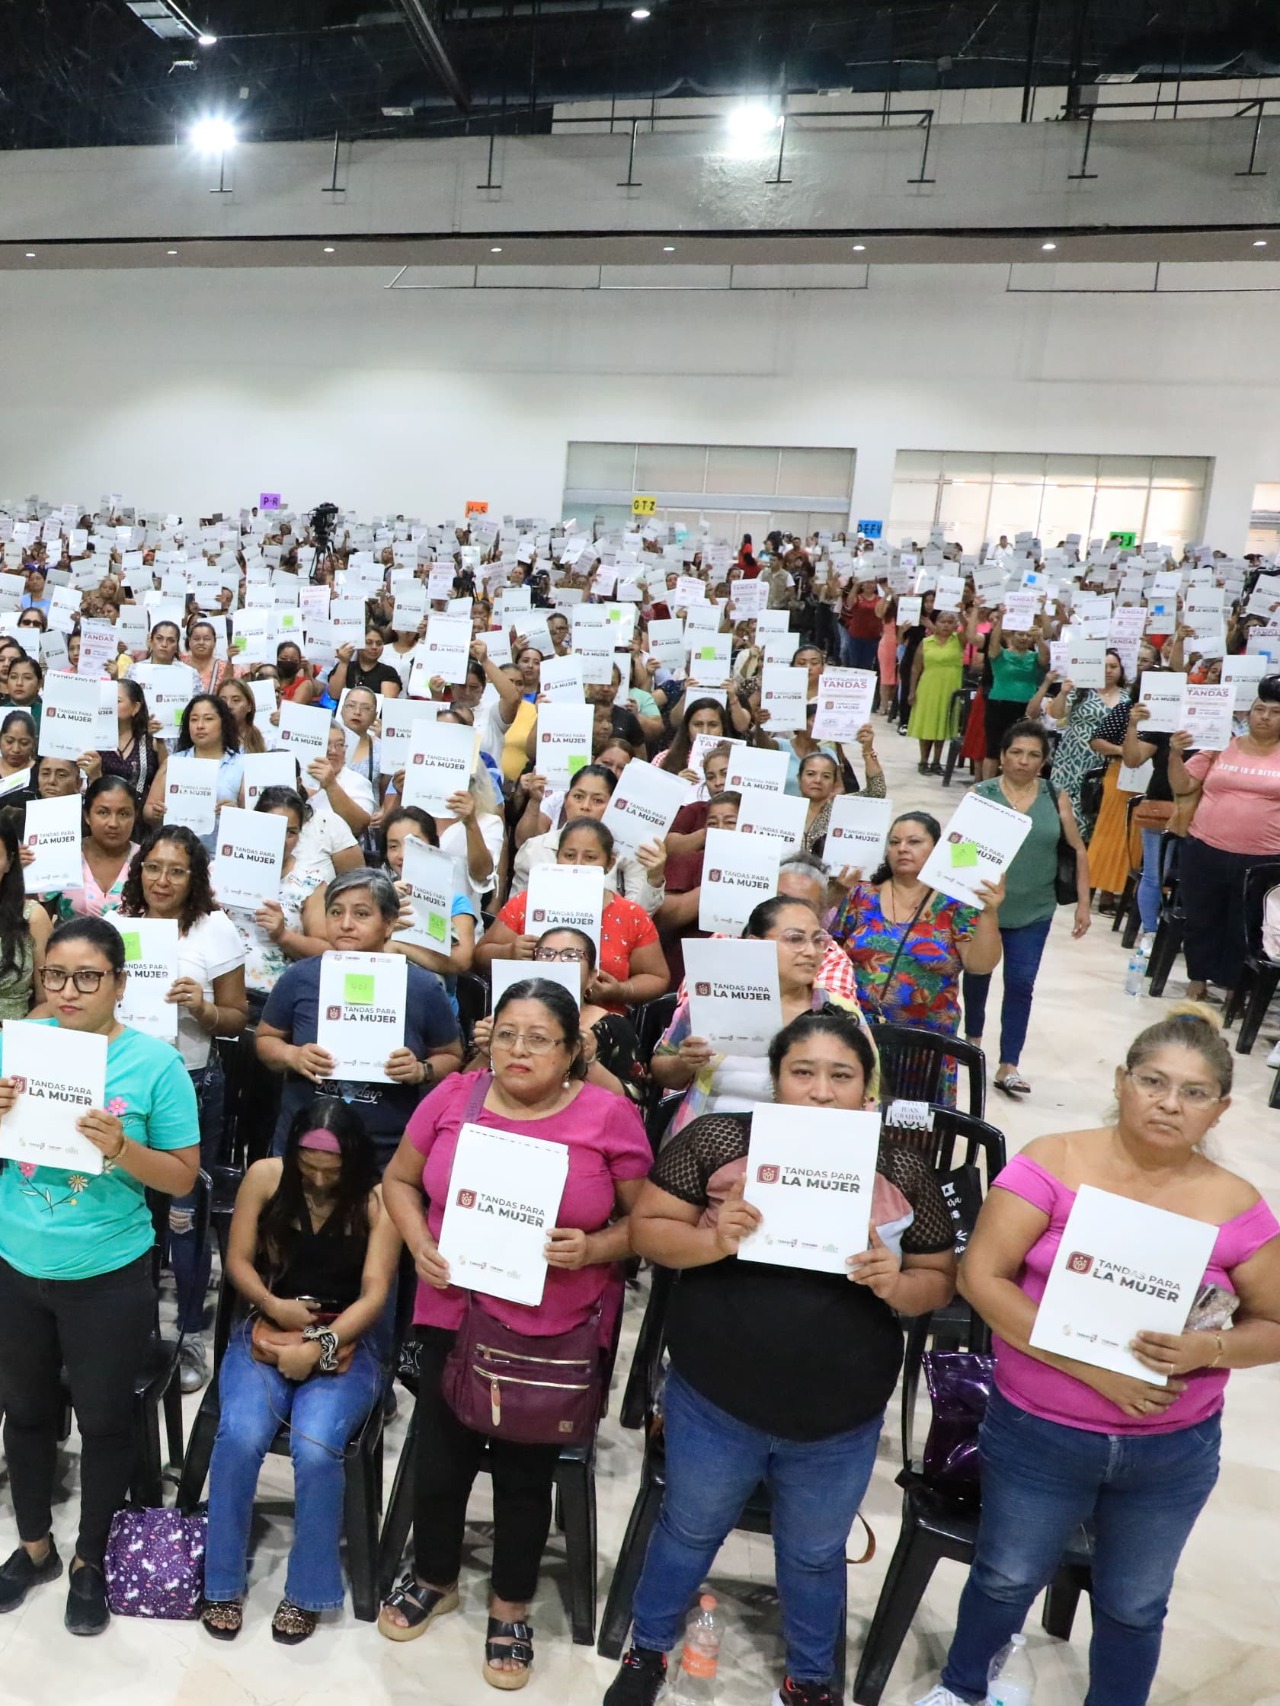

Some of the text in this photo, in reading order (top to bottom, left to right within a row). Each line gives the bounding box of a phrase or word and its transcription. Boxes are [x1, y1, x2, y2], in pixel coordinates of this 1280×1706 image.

[83, 633, 115, 642] TANDAS
[823, 681, 868, 690] TANDAS
[68, 714, 92, 723] MUJER
[301, 738, 322, 746] MUJER
[437, 762, 465, 770] MUJER
[753, 782, 778, 791] MUJER
[626, 808, 665, 827] LA MUJER
[50, 836, 75, 844] MUJER
[855, 834, 880, 842] MUJER
[246, 854, 275, 864] MUJER
[724, 870, 750, 879] TANDAS
[736, 879, 769, 890] MUJER
[423, 893, 446, 907] MUJER
[561, 916, 594, 925] MUJER
[134, 970, 168, 978] MUJER
[713, 983, 745, 991] TANDAS
[714, 989, 770, 1001] LA MUJER
[360, 1014, 396, 1024] MUJER
[30, 1079, 92, 1096] TANDAS PARA
[29, 1088, 92, 1106] LA MUJER
[784, 1166, 860, 1182] TANDAS PARA
[781, 1175, 861, 1194] LA MUJER
[480, 1193, 545, 1217] TANDAS PARA
[477, 1201, 544, 1228] LA MUJER
[1098, 1258, 1181, 1291] TANDAS PARA
[1092, 1268, 1180, 1303] LA MUJER
